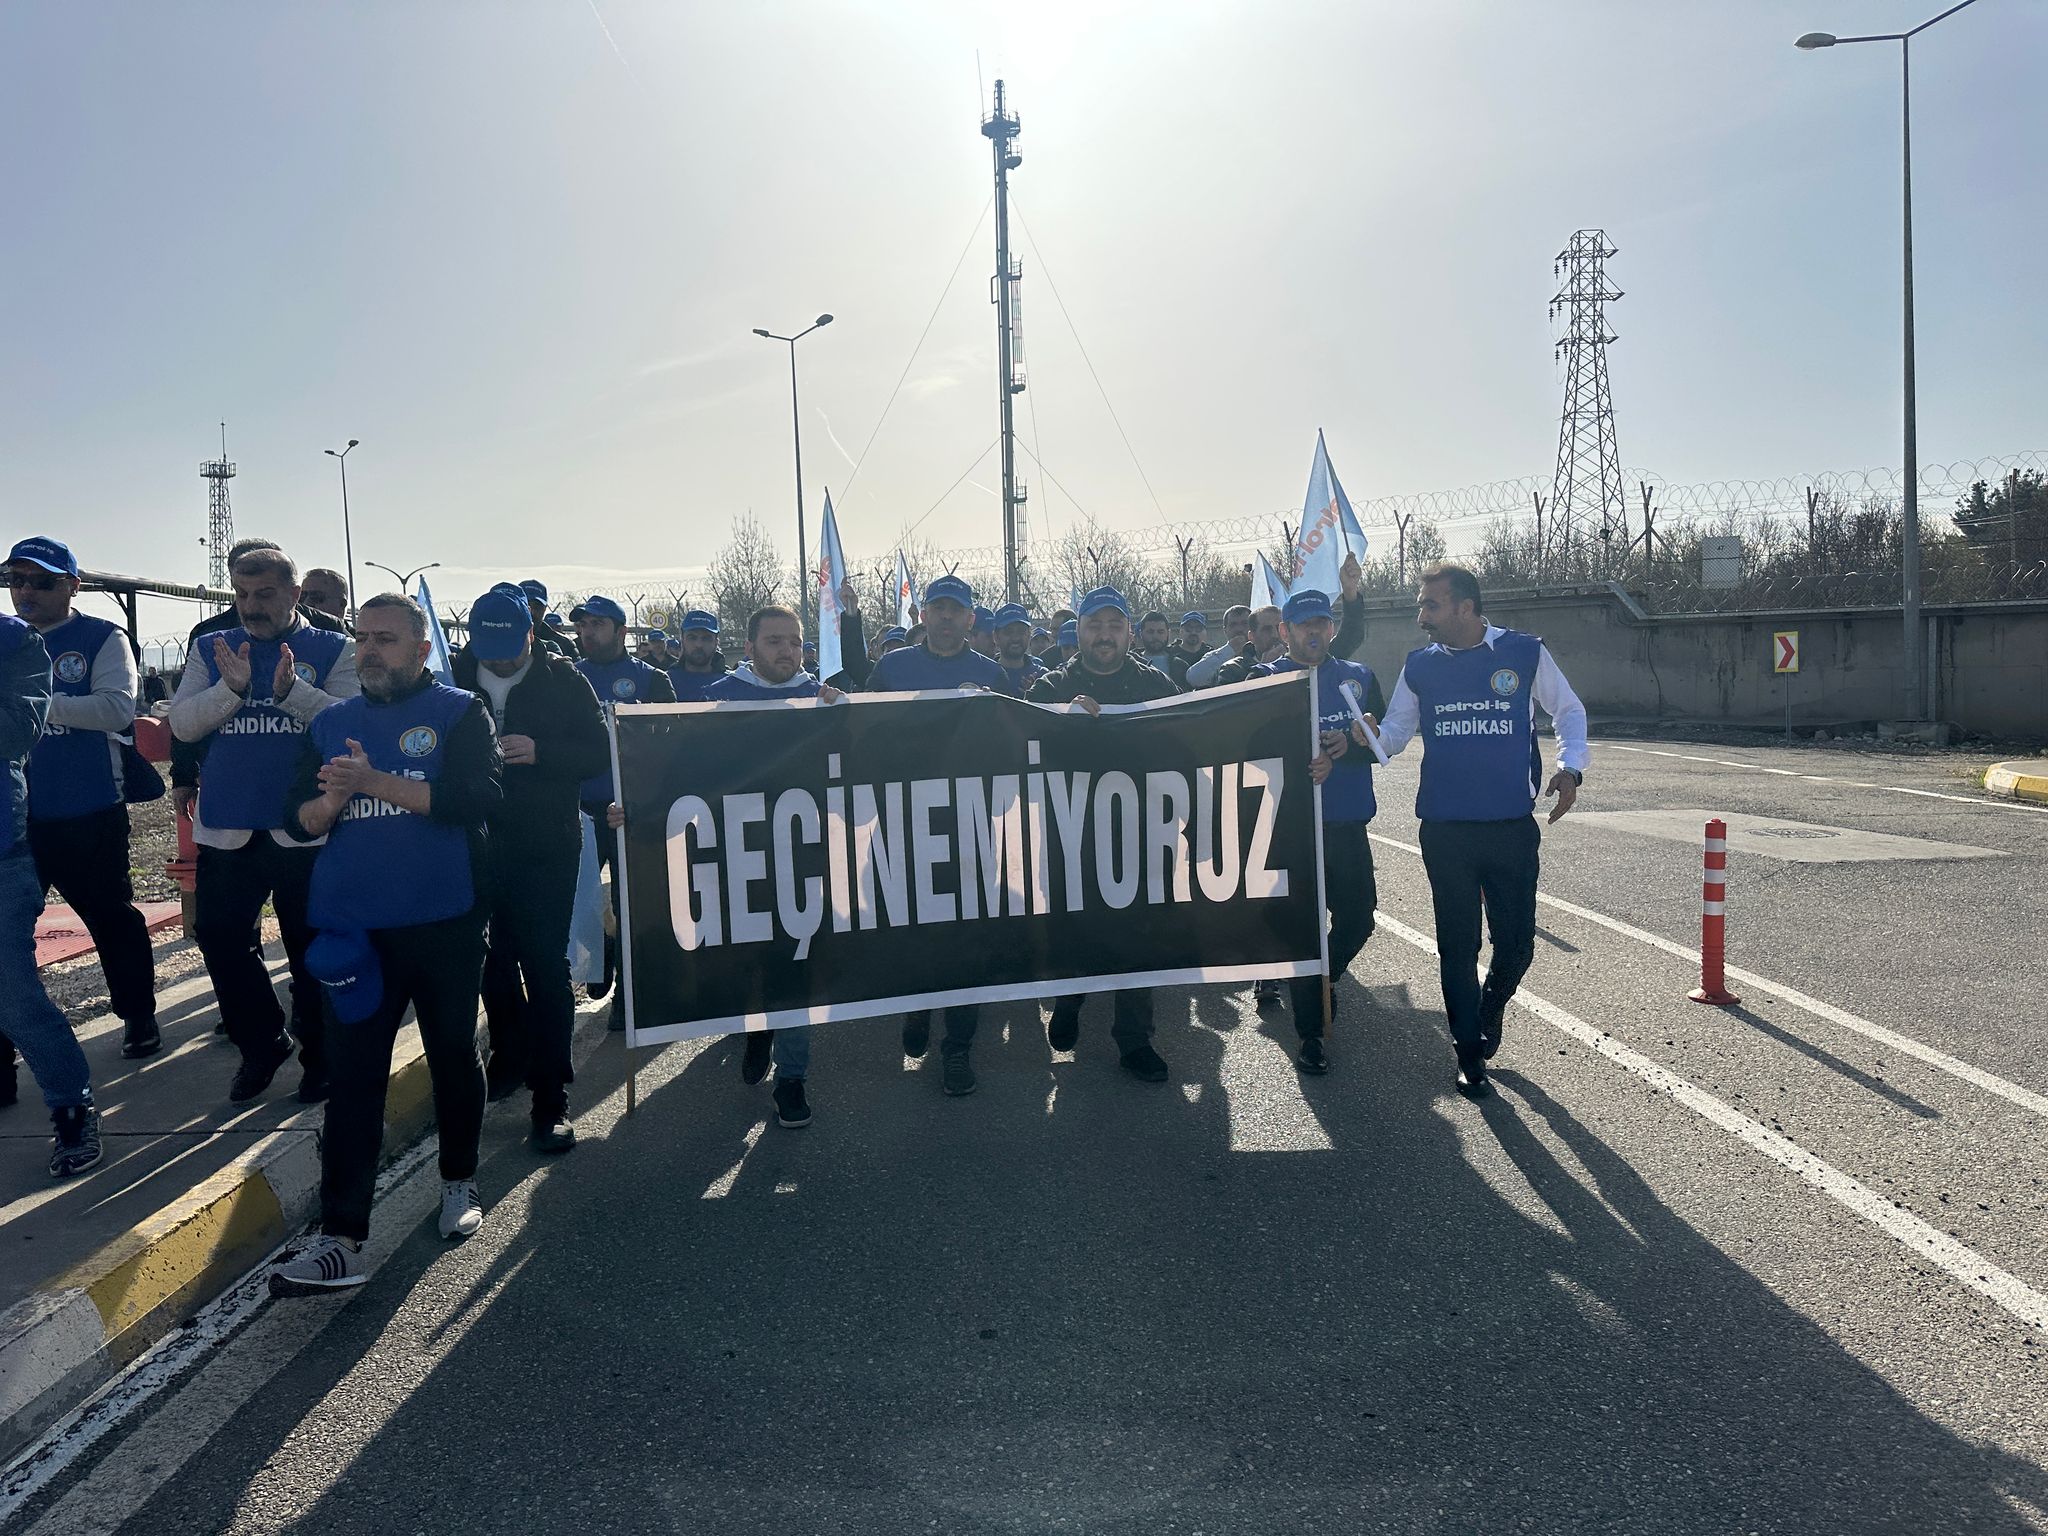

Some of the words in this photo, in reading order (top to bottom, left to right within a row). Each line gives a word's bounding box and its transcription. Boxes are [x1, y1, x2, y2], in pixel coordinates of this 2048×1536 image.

[652, 616, 664, 625] 40
[1434, 700, 1511, 715] petrol-iş
[1435, 716, 1513, 737] SENDİKASI
[665, 740, 1290, 961] GEÇİNEMİYORUZ
